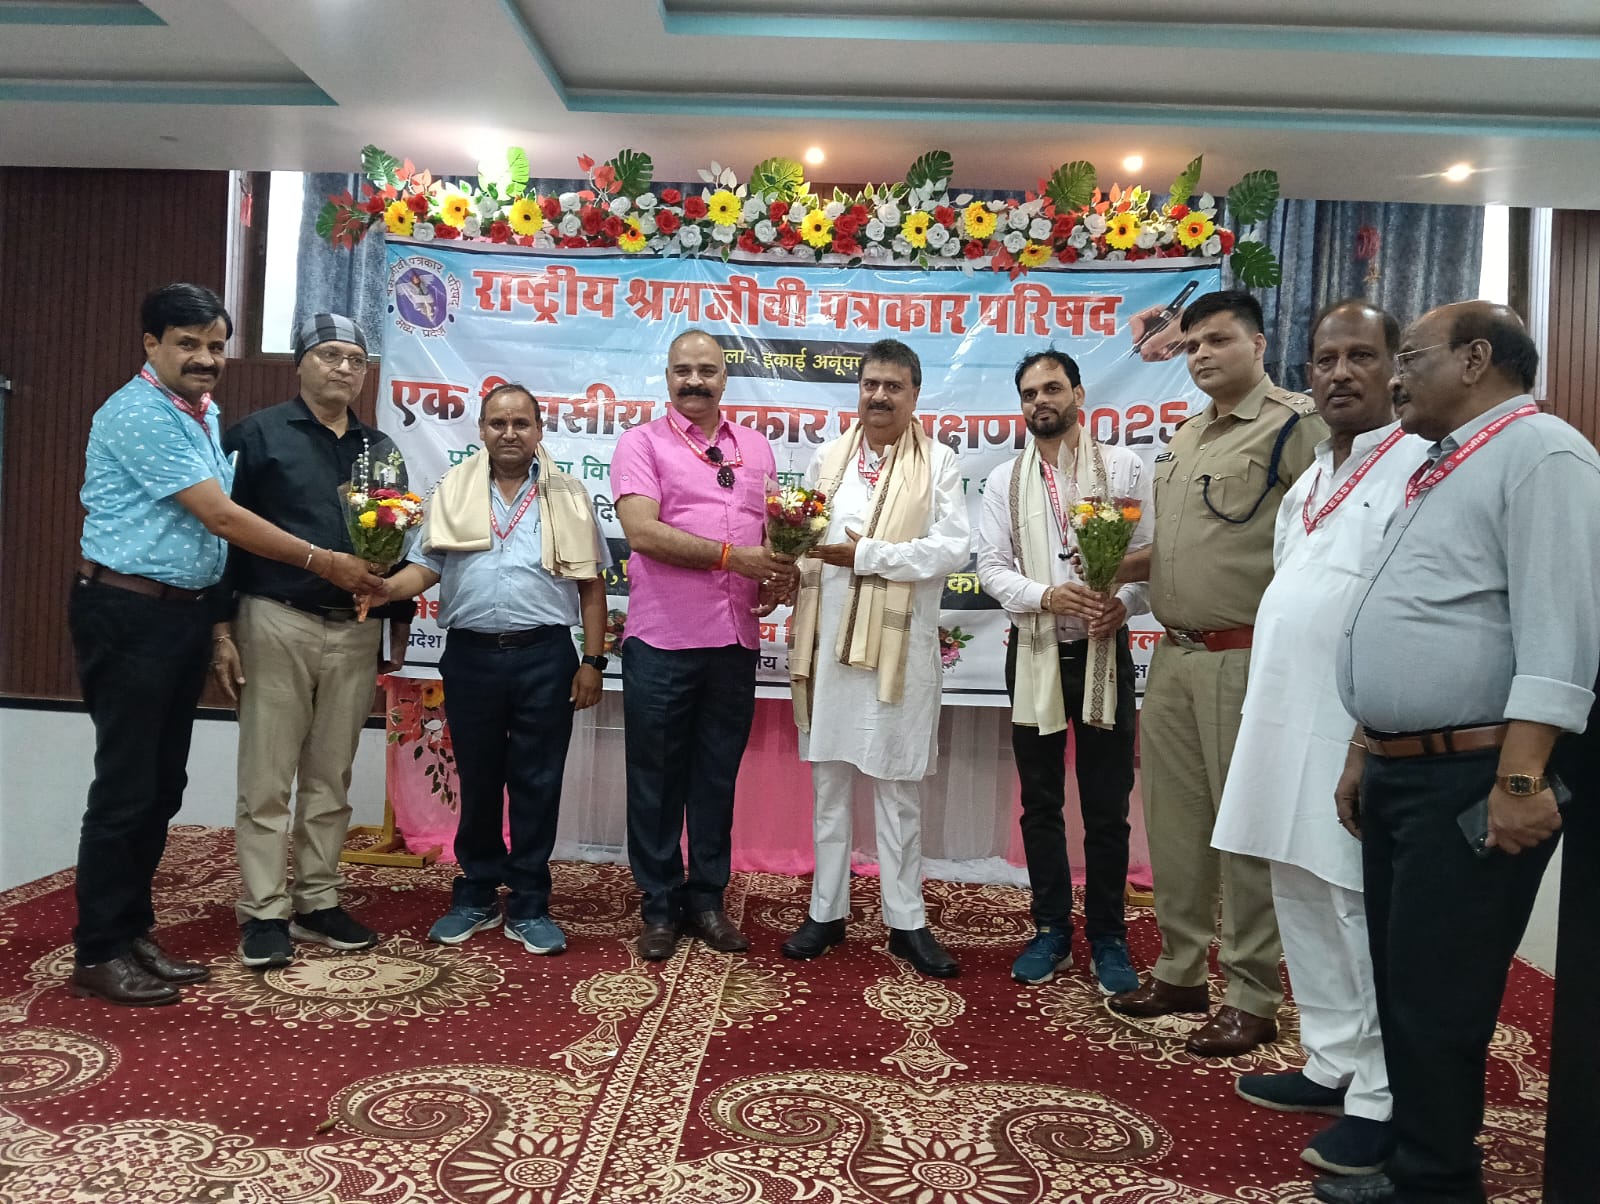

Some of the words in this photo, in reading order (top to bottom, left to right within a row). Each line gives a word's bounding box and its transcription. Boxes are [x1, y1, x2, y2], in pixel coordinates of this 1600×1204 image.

[472, 264, 620, 324] राष्ट्रीय
[625, 276, 812, 328] श्रमजीवी
[818, 288, 971, 335] पत्रकार
[978, 282, 1122, 336] परिषद
[762, 347, 807, 371] इकाई
[391, 379, 469, 427] एक
[1078, 401, 1188, 447] 025
